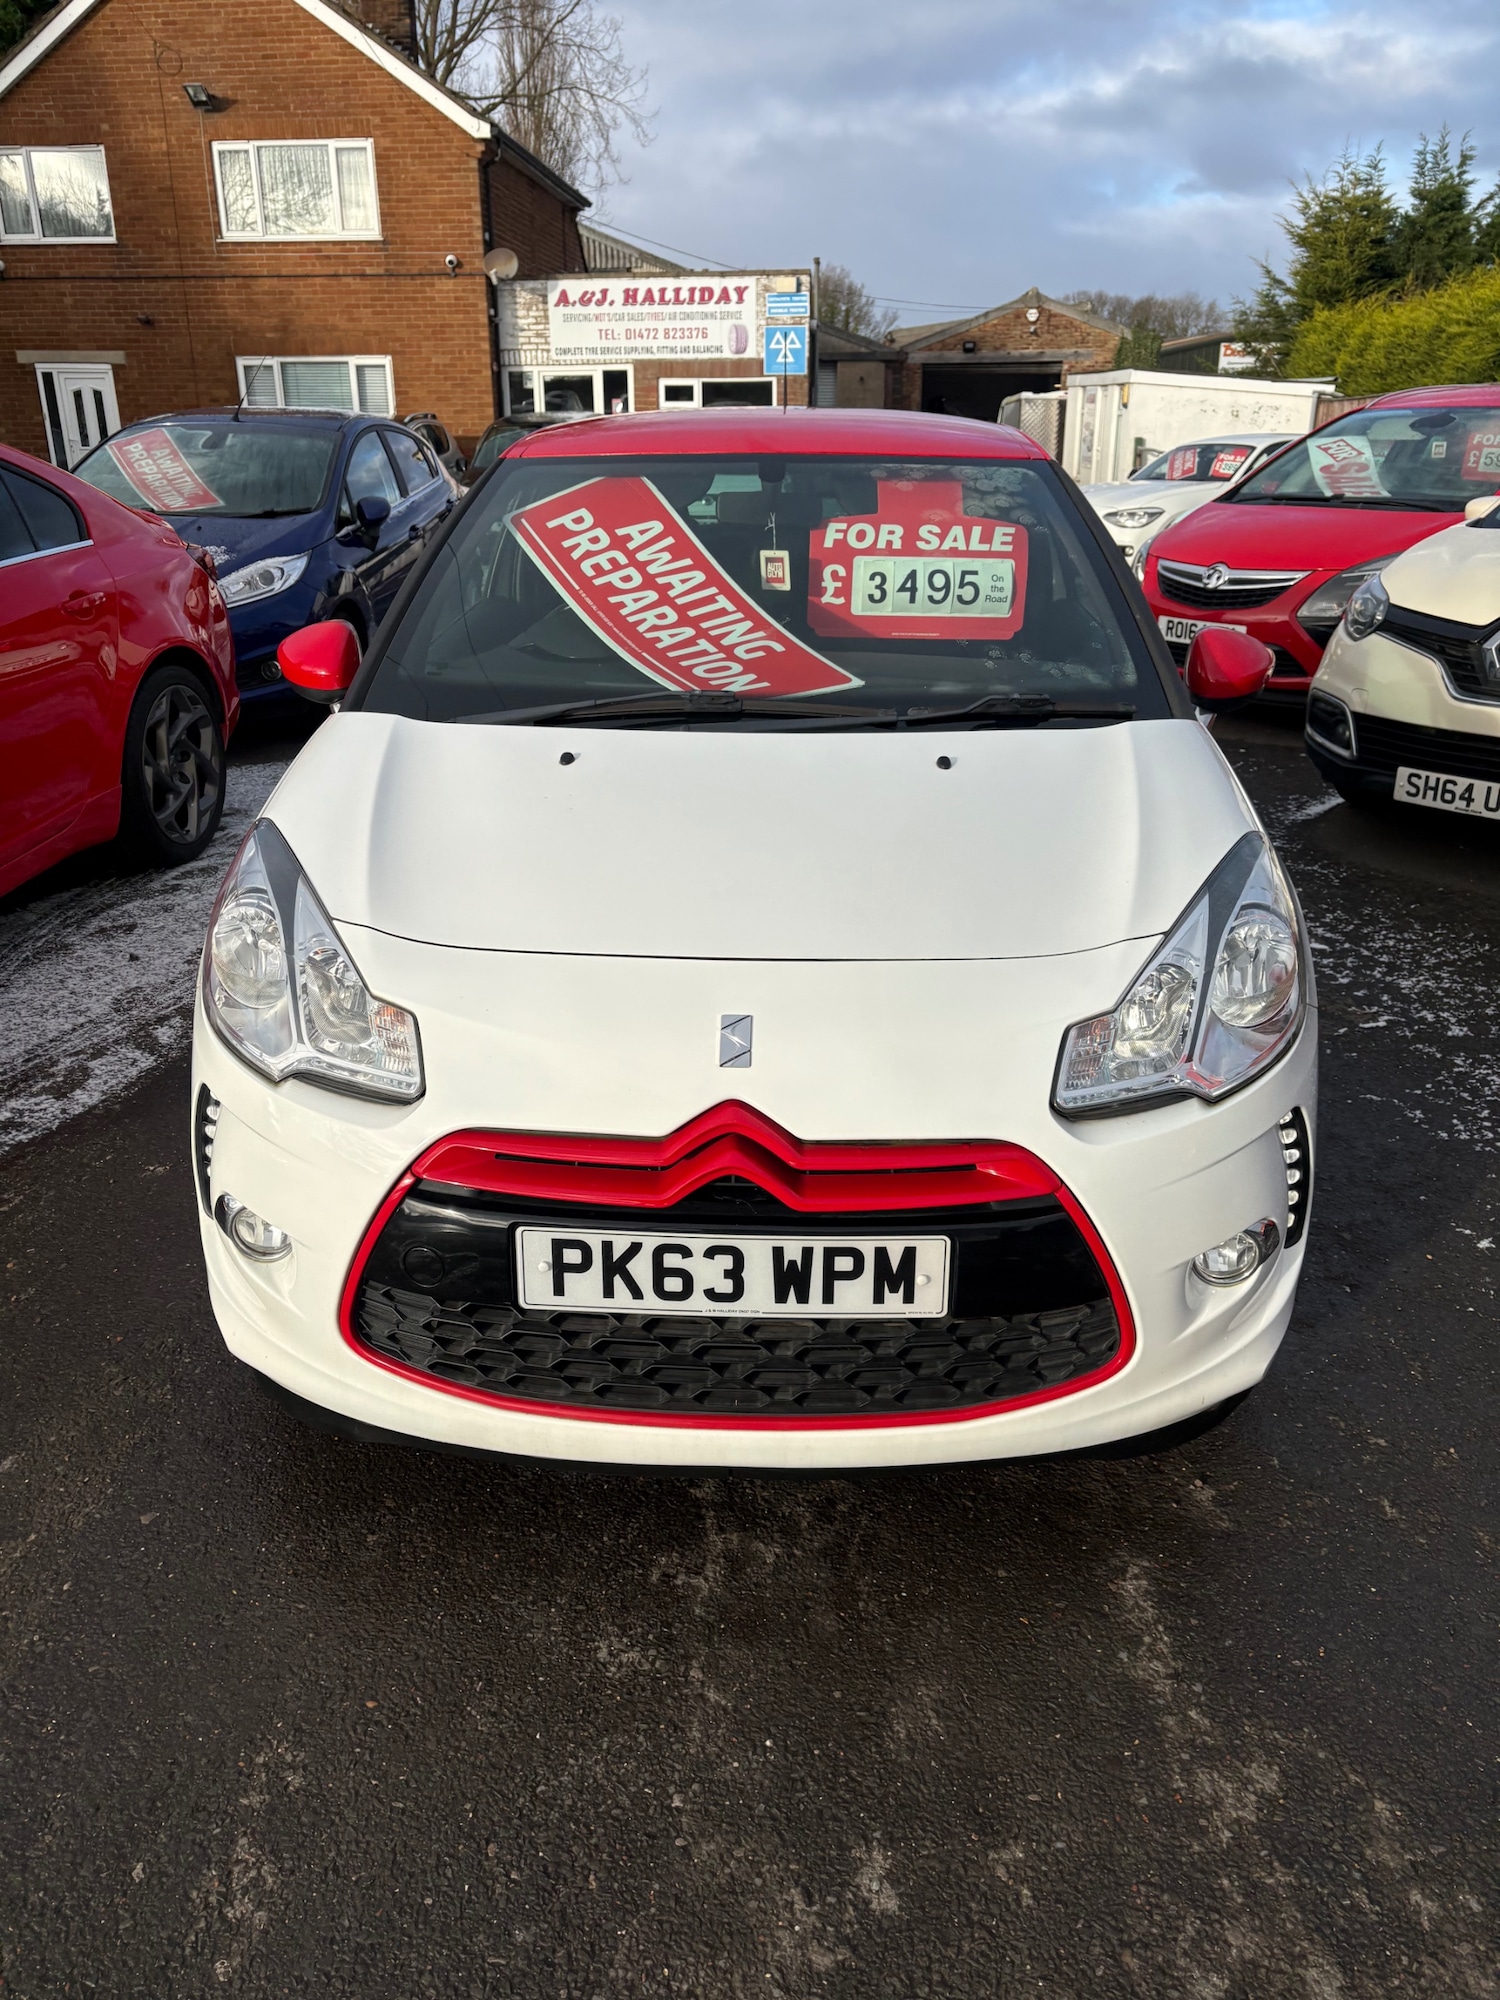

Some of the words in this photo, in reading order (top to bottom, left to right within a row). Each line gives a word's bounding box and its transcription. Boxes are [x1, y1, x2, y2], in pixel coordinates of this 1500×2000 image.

[622, 286, 749, 306] HALLIDAY
[679, 311, 718, 321] CONDITIONING
[719, 310, 743, 320] SERVICE
[598, 328, 621, 340] TEL:
[625, 327, 659, 340] 01472
[663, 327, 708, 340] 823376
[555, 346, 583, 356] COMPLETE
[585, 346, 598, 355] TYRE
[600, 346, 622, 355] SERVICE
[657, 345, 678, 354] FITTING
[680, 345, 691, 354] AND
[692, 345, 724, 354] BALANCING
[1320, 441, 1359, 461] FOR
[122, 442, 190, 509] PREPARATION
[150, 448, 204, 497] AWAITING
[823, 522, 904, 550] FOR
[915, 524, 1016, 552] SALE
[614, 520, 787, 661] AWAITING
[867, 569, 980, 605] 3495
[990, 584, 1005, 593] the
[991, 574, 1005, 583] On
[545, 507, 771, 692] PREPARATION
[984, 594, 1009, 603] Road
[1405, 772, 1476, 809] SH64
[551, 1237, 746, 1304] PK63
[771, 1245, 918, 1306] WPM
